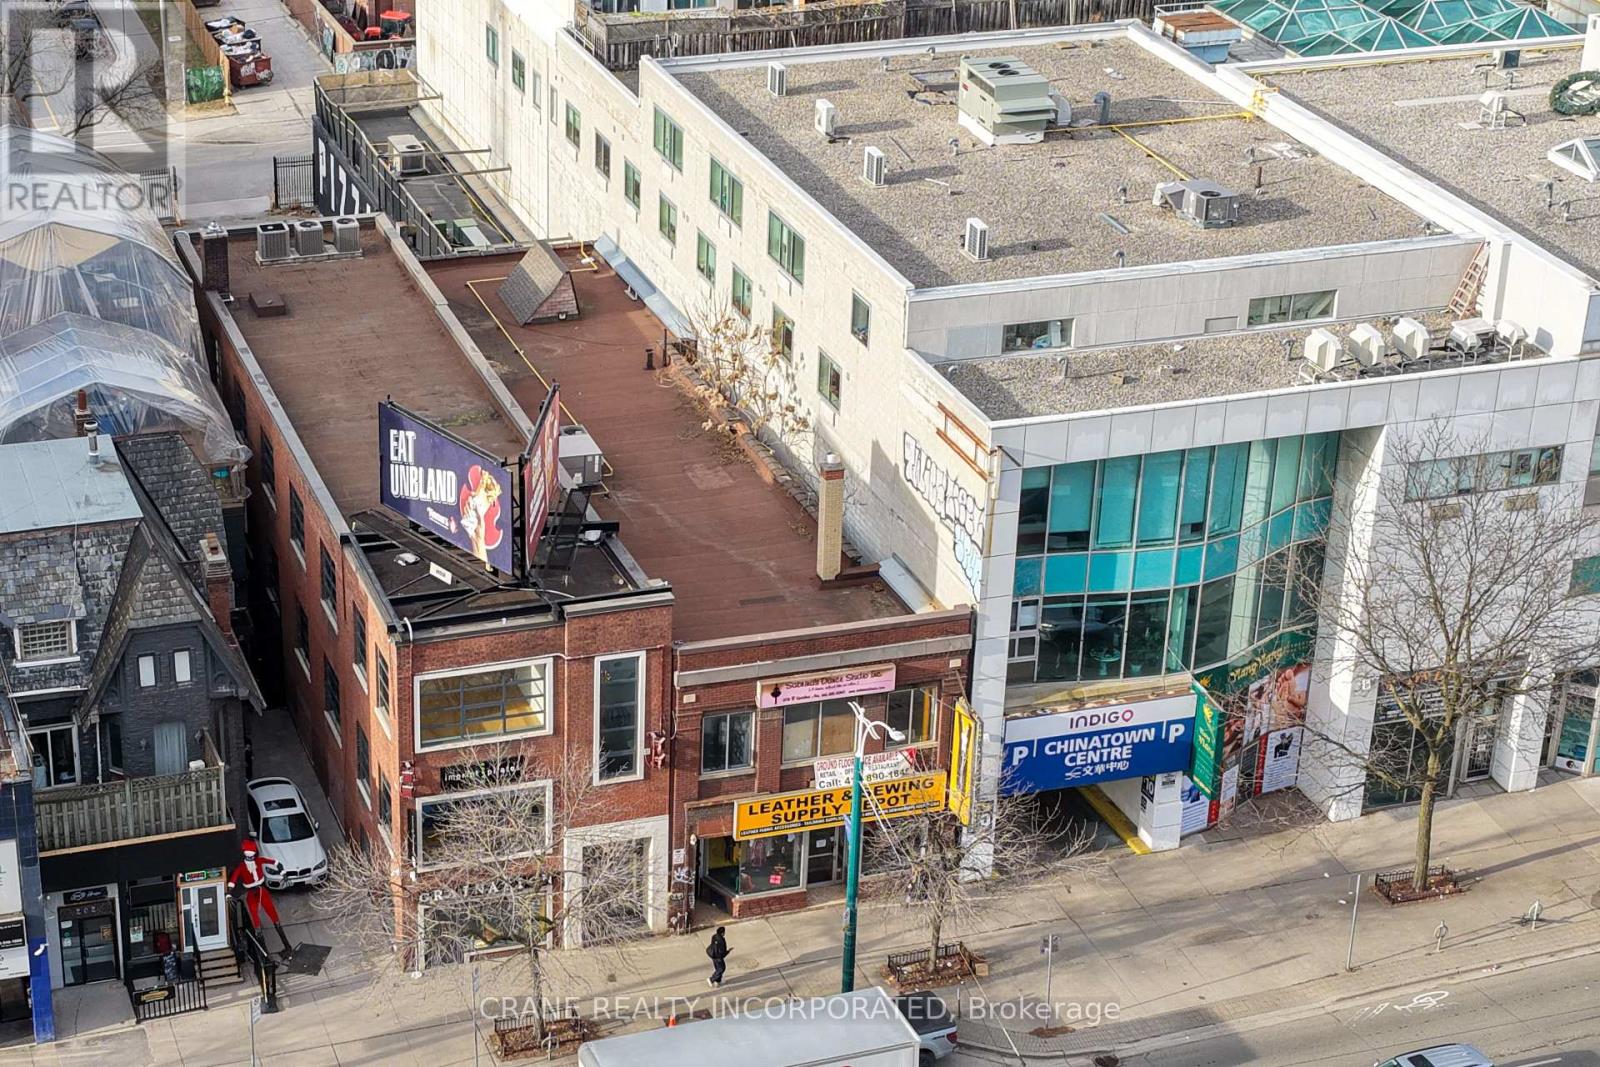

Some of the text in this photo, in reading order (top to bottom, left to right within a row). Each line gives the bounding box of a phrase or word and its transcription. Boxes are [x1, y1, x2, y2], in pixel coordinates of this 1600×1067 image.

[389, 429, 416, 465] EAT
[390, 463, 457, 505] UNBLAND
[820, 676, 844, 686] Dance
[845, 672, 869, 682] Studio
[1069, 709, 1134, 729] INDIGO
[1044, 727, 1156, 756] CHINATOWN
[1168, 724, 1186, 743] P
[1012, 746, 1029, 766] P
[1064, 745, 1133, 767] CENTRE
[818, 779, 842, 789] Call:
[749, 778, 935, 815] LEATHER & SEWING
[771, 803, 843, 824] SUPPLY
[863, 794, 911, 810] EPOT
